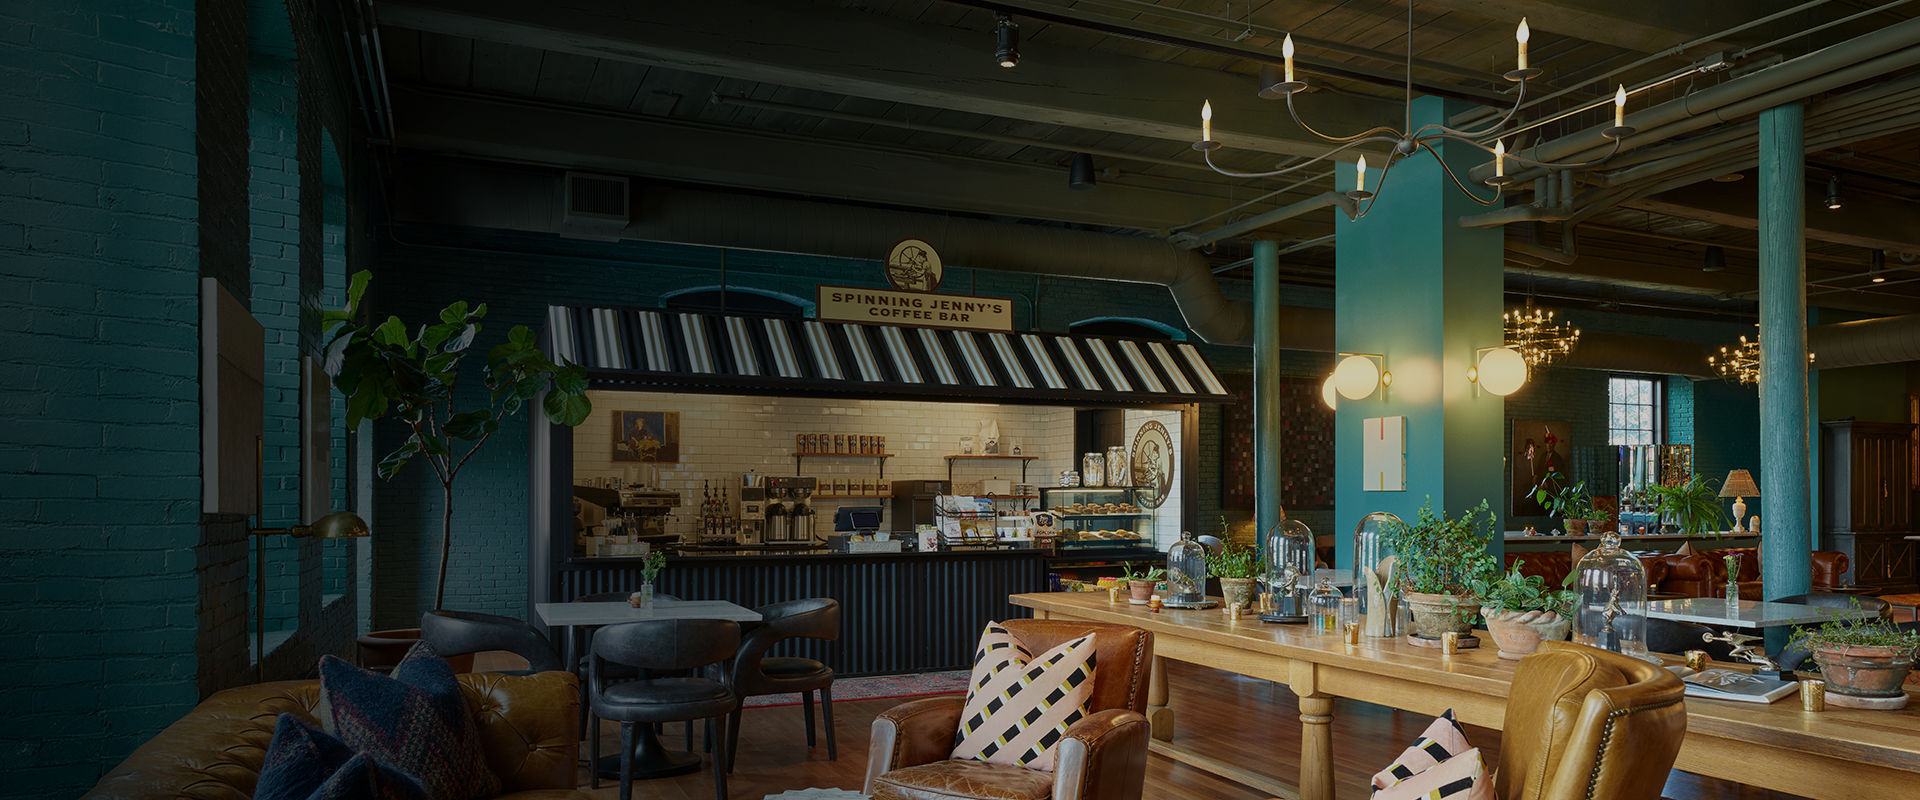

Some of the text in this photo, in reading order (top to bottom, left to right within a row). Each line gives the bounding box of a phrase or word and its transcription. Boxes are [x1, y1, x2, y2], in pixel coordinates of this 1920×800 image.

[832, 293, 1003, 314] SPINNING JENNY'S
[869, 307, 970, 322] COFFEE BAR
[1132, 423, 1173, 457] SPINNING JENNY'S
